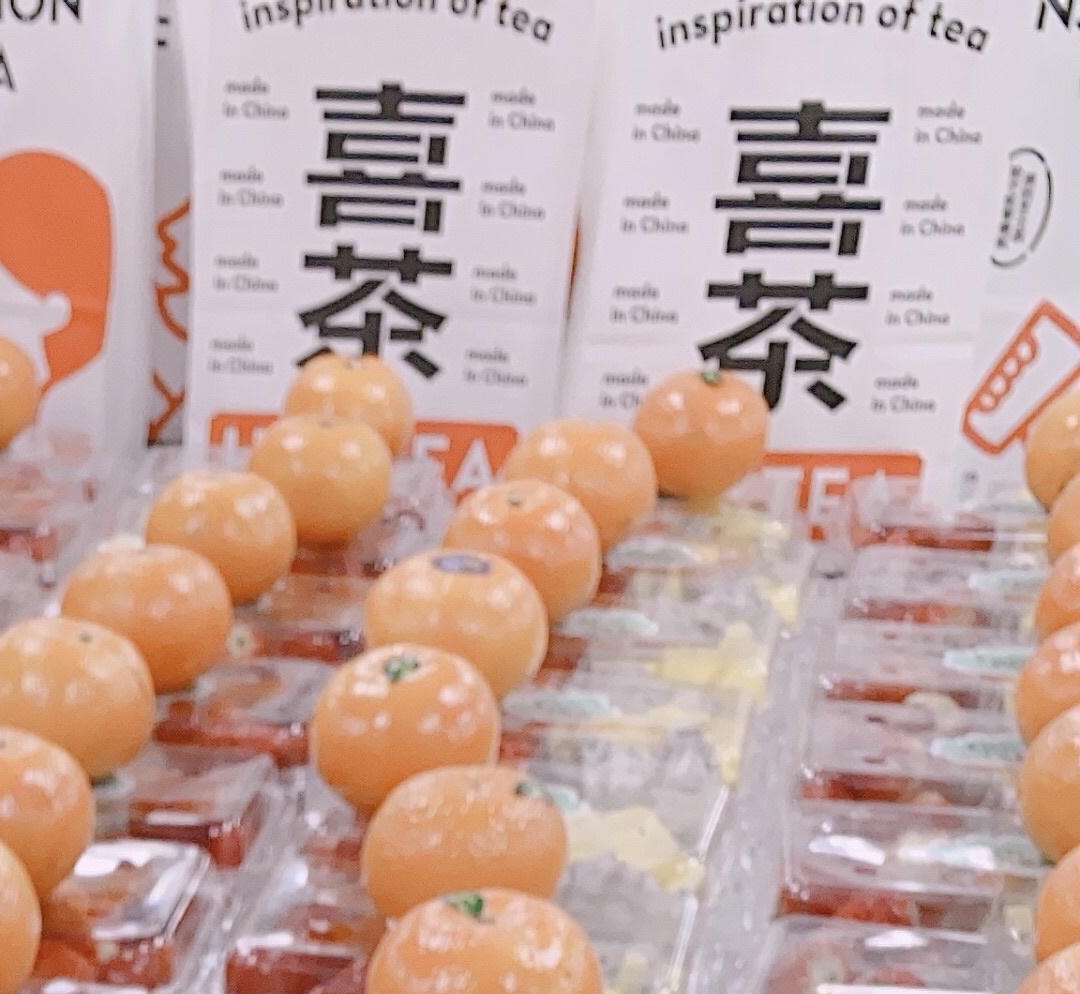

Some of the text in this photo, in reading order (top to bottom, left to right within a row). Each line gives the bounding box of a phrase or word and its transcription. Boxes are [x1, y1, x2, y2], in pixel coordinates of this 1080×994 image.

[498, 1, 552, 41] tea
[656, 0, 865, 48] inspiration
[878, 0, 917, 30] of
[930, 3, 988, 51] tea
[296, 84, 465, 379] 喜茶
[697, 101, 890, 411] 喜茶
